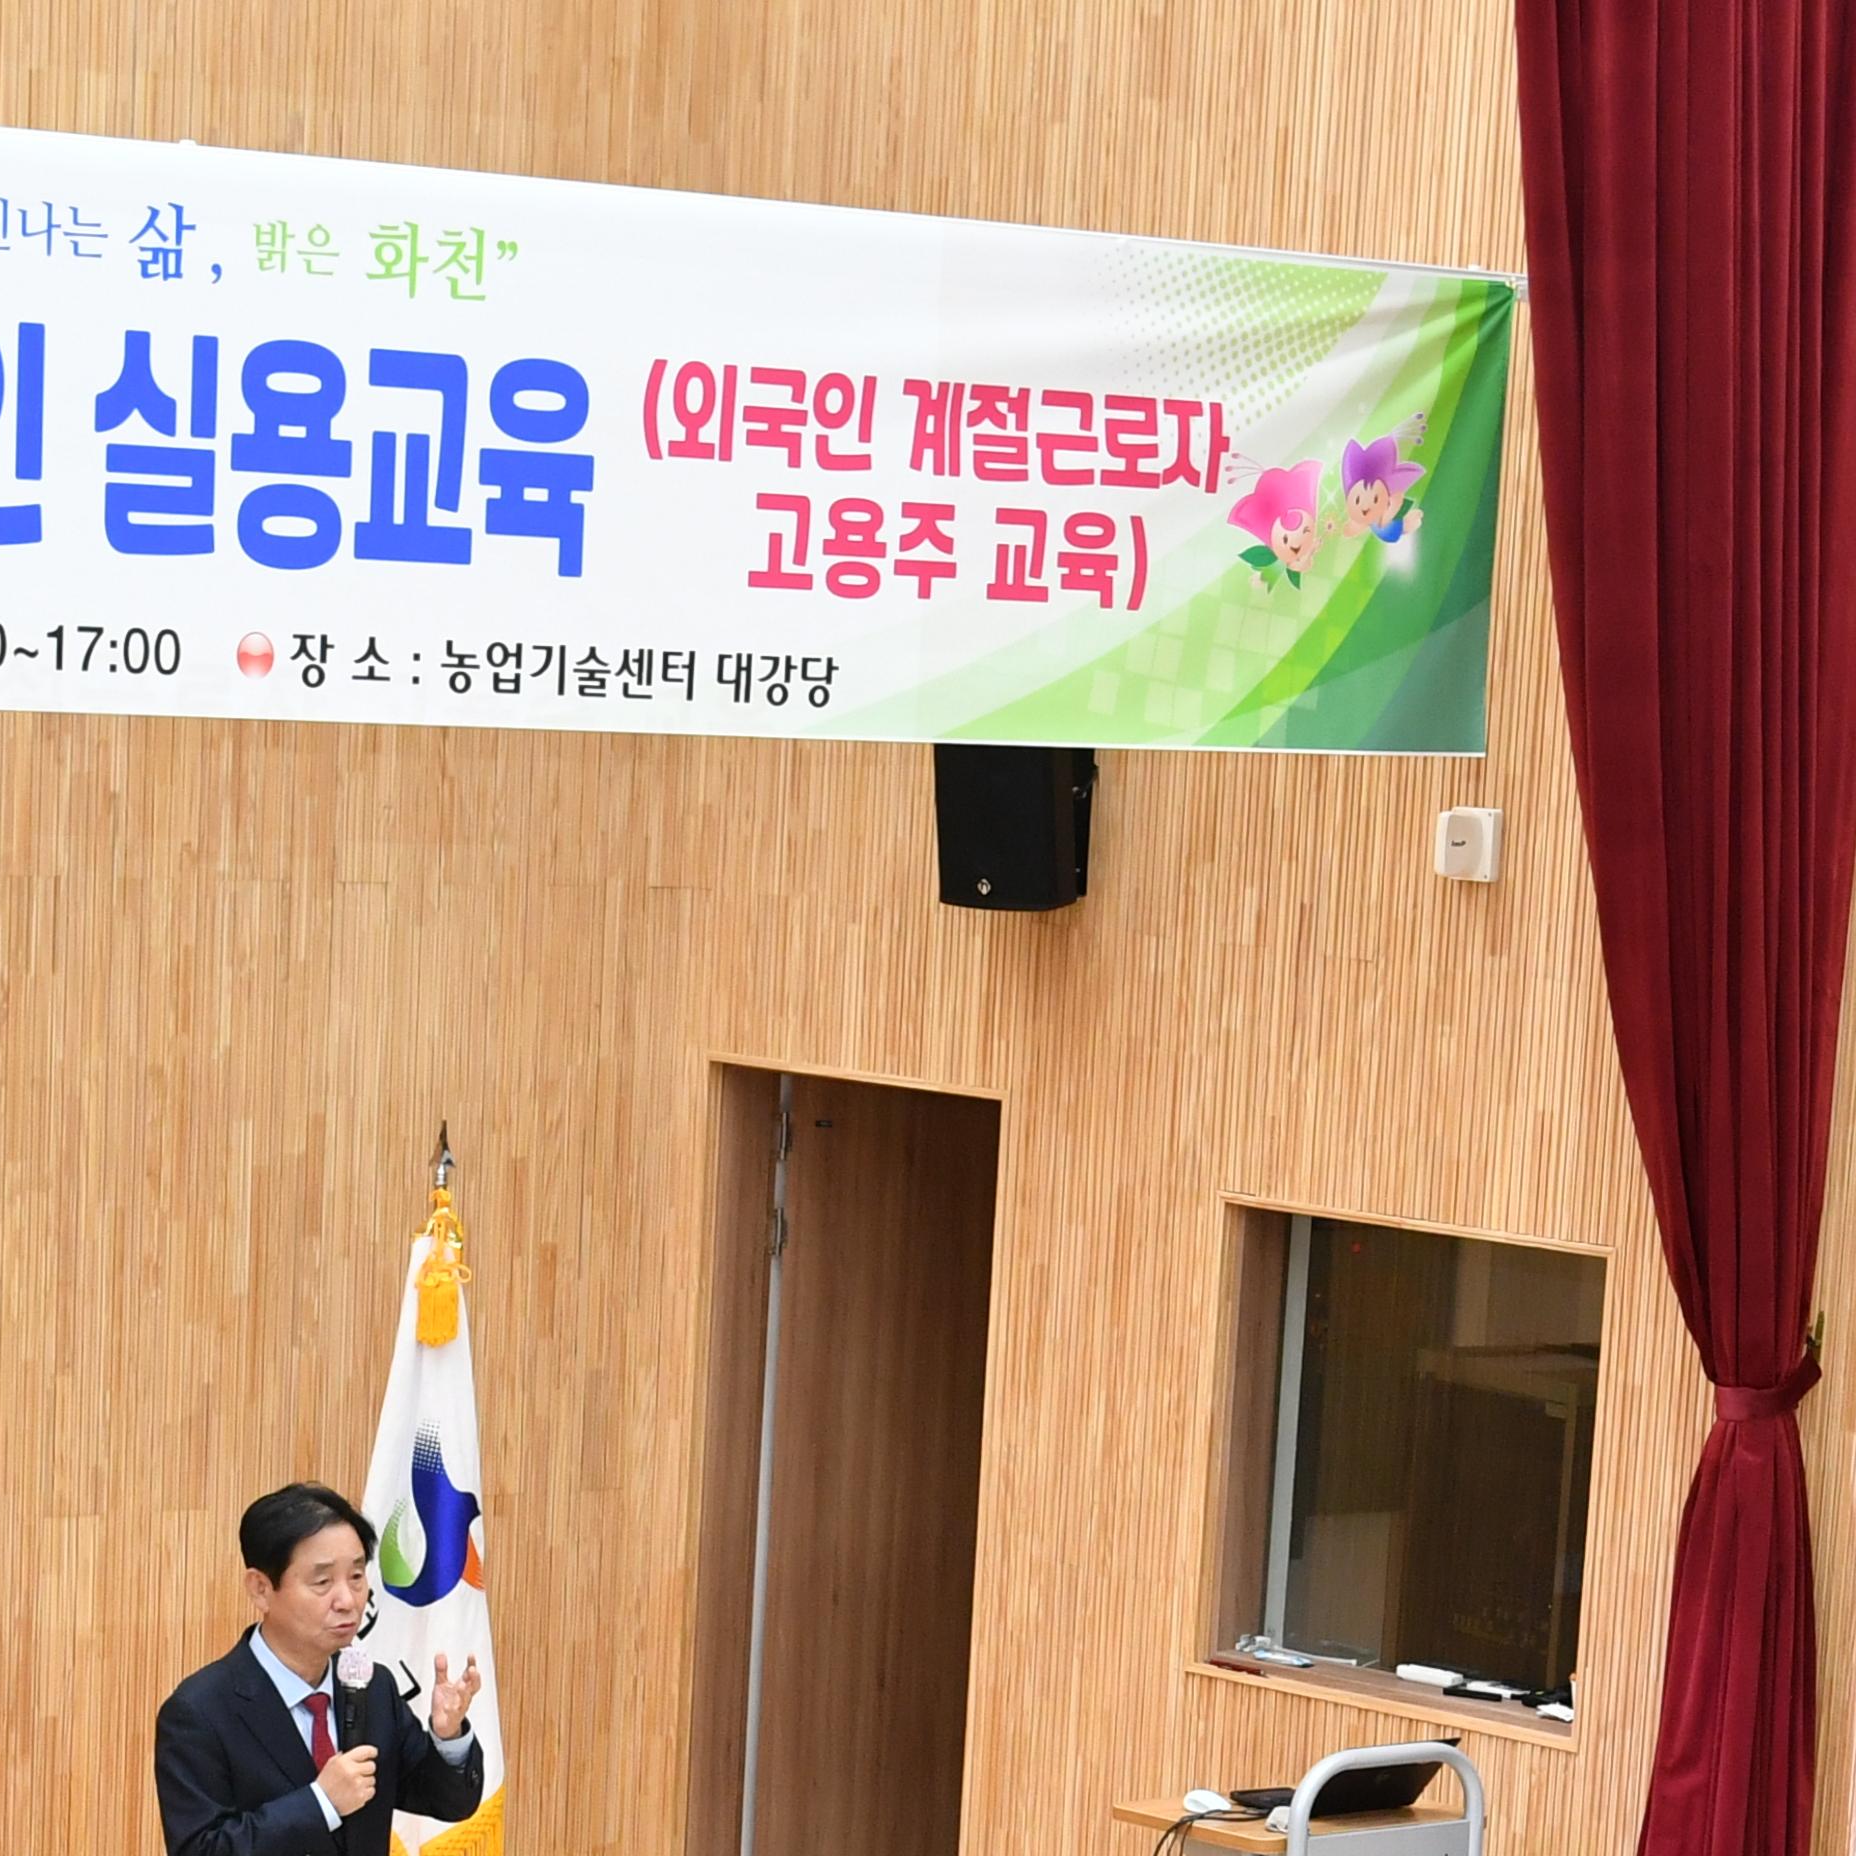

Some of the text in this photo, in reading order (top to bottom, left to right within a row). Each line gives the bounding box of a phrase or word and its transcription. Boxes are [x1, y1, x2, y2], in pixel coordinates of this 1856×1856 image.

[253, 219, 340, 276] 밝은
[94, 329, 595, 578] 실용교육
[642, 358, 1231, 494] (외국인 계절근로자
[747, 492, 1148, 612] 고용주 교육)
[439, 639, 697, 702] 농업기술센터
[716, 651, 841, 709] 대강당
